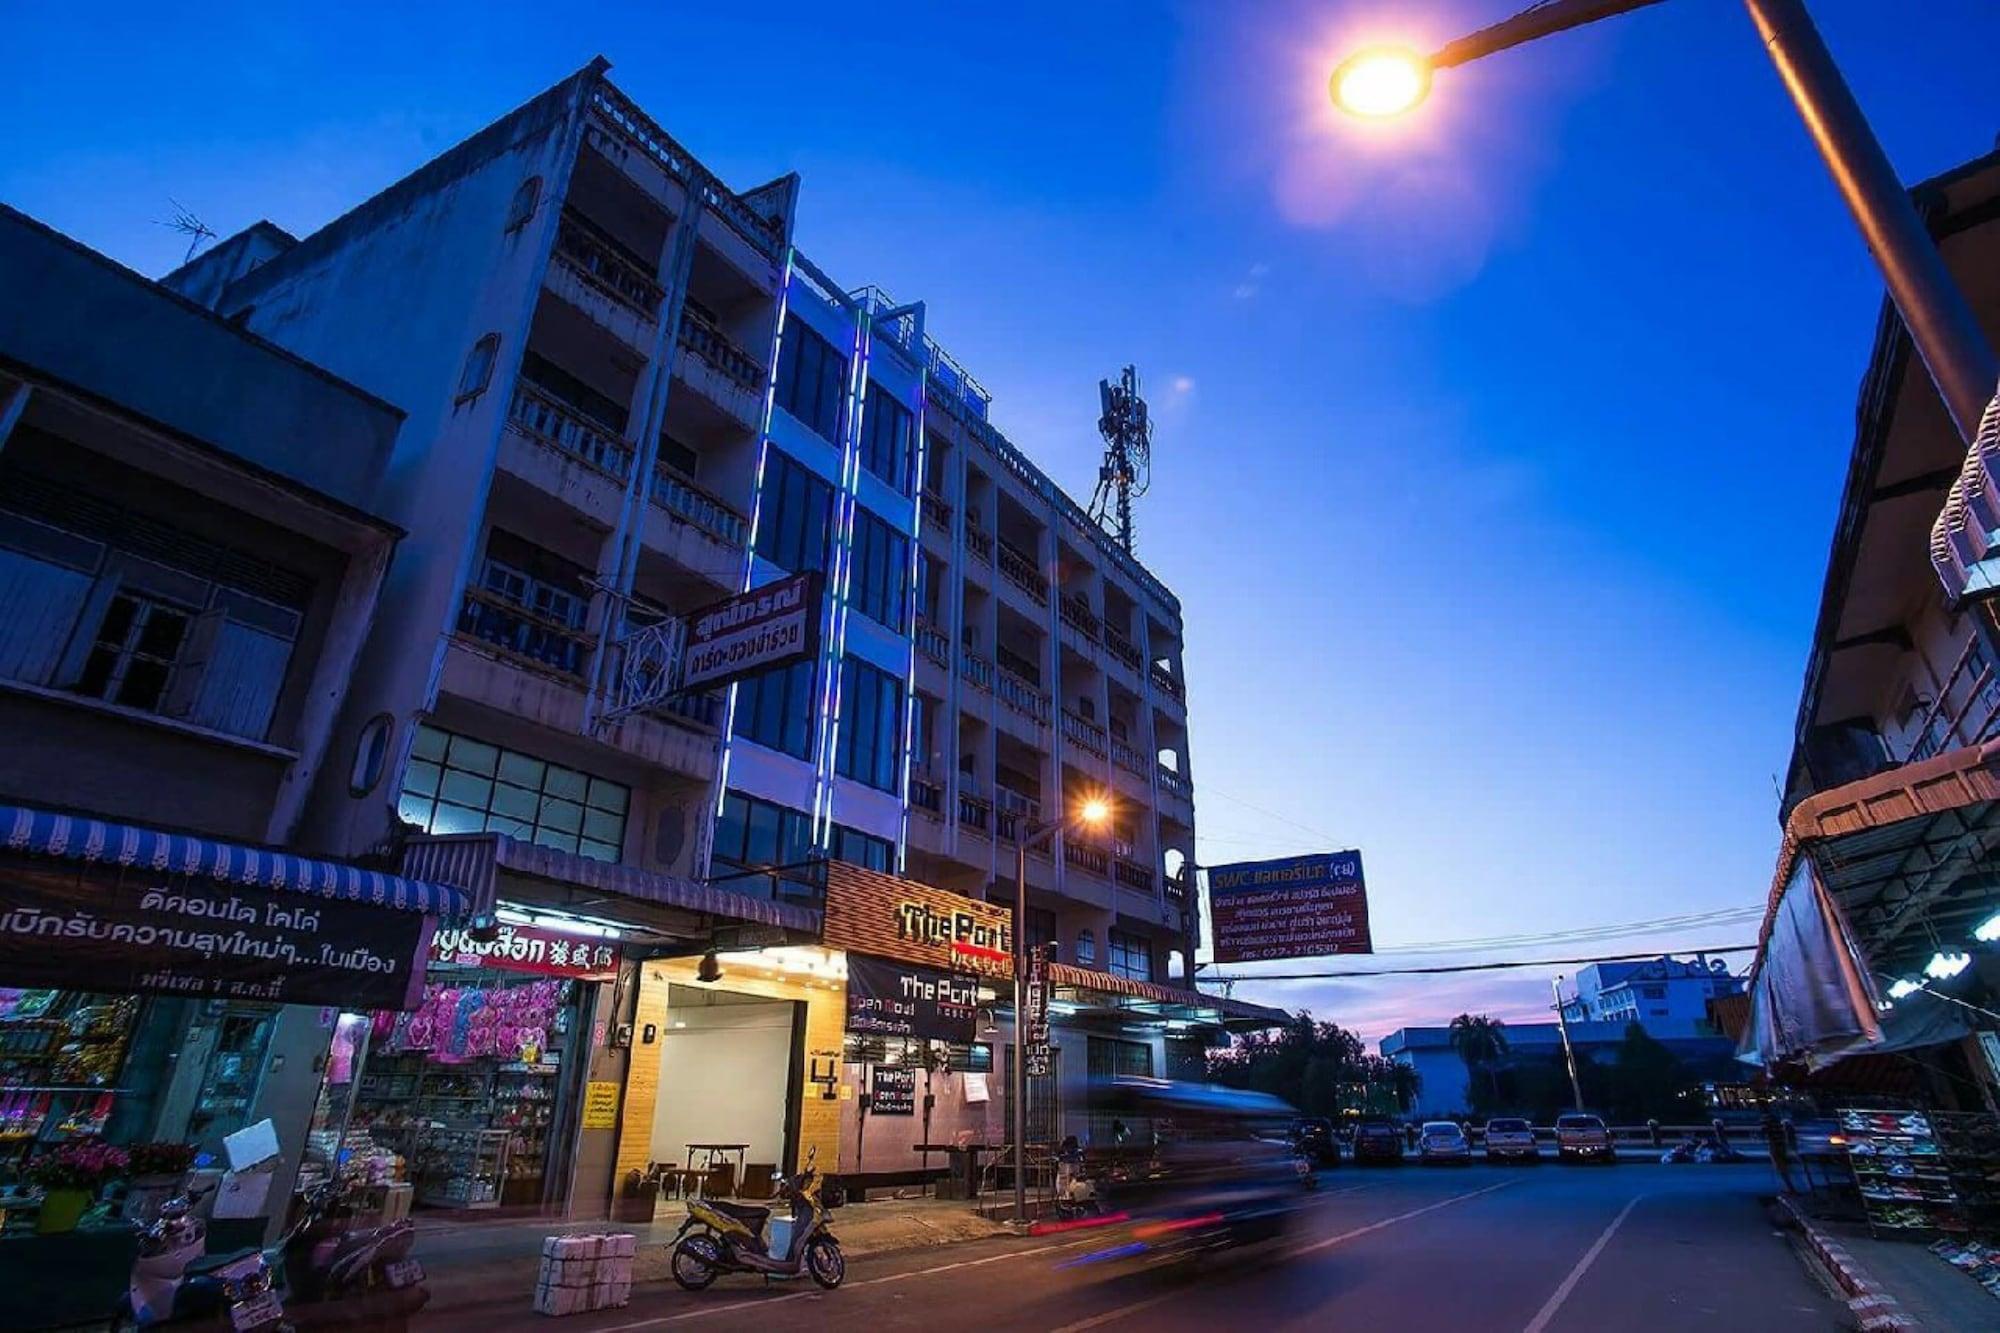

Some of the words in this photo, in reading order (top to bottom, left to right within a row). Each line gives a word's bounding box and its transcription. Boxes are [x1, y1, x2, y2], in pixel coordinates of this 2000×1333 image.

[140, 887, 257, 925] ดีคอนโด
[265, 902, 321, 932] โคโค่
[897, 900, 951, 948] The
[951, 910, 1011, 952] Port
[900, 974, 936, 1001] The
[937, 978, 977, 1007] Port
